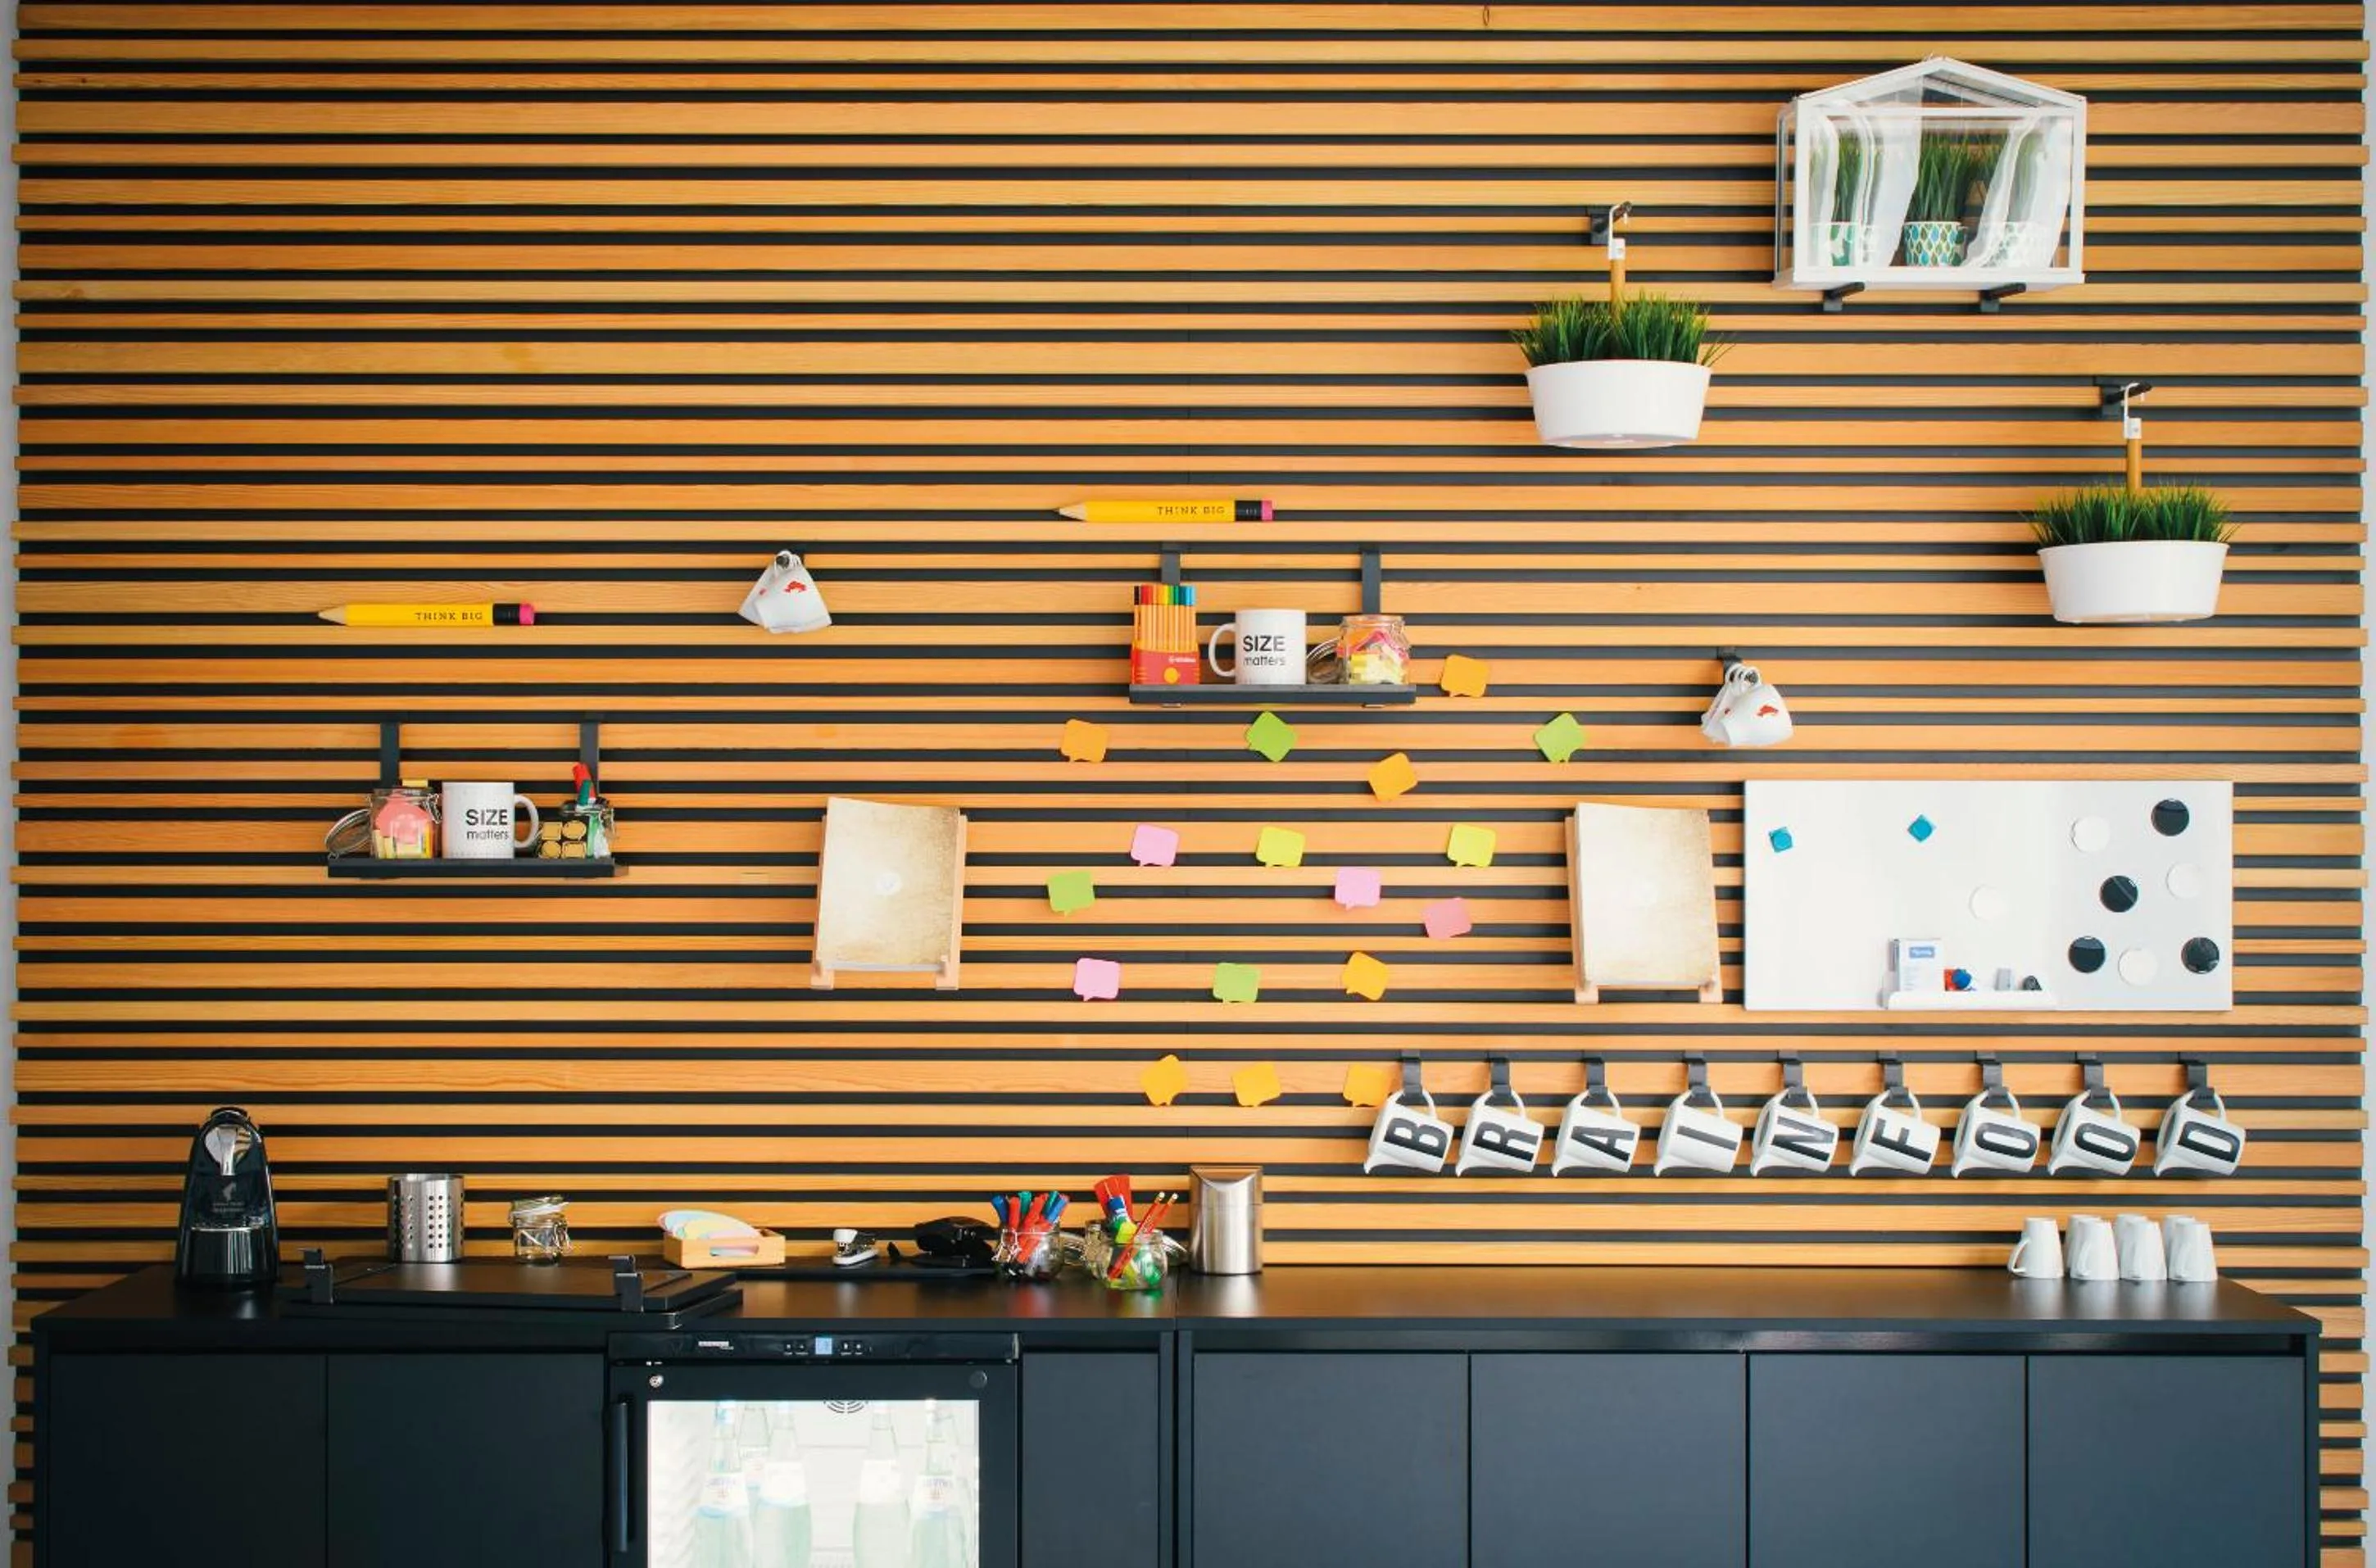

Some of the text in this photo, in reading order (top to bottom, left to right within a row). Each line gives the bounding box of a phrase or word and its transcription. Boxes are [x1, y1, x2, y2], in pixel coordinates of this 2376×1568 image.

[1157, 505, 1226, 515] THINK BIG
[415, 612, 483, 620] THINK BIG
[1243, 635, 1285, 652] SIZE
[1243, 655, 1285, 666] matters
[465, 809, 508, 826] SIZE
[466, 829, 509, 840] matters
